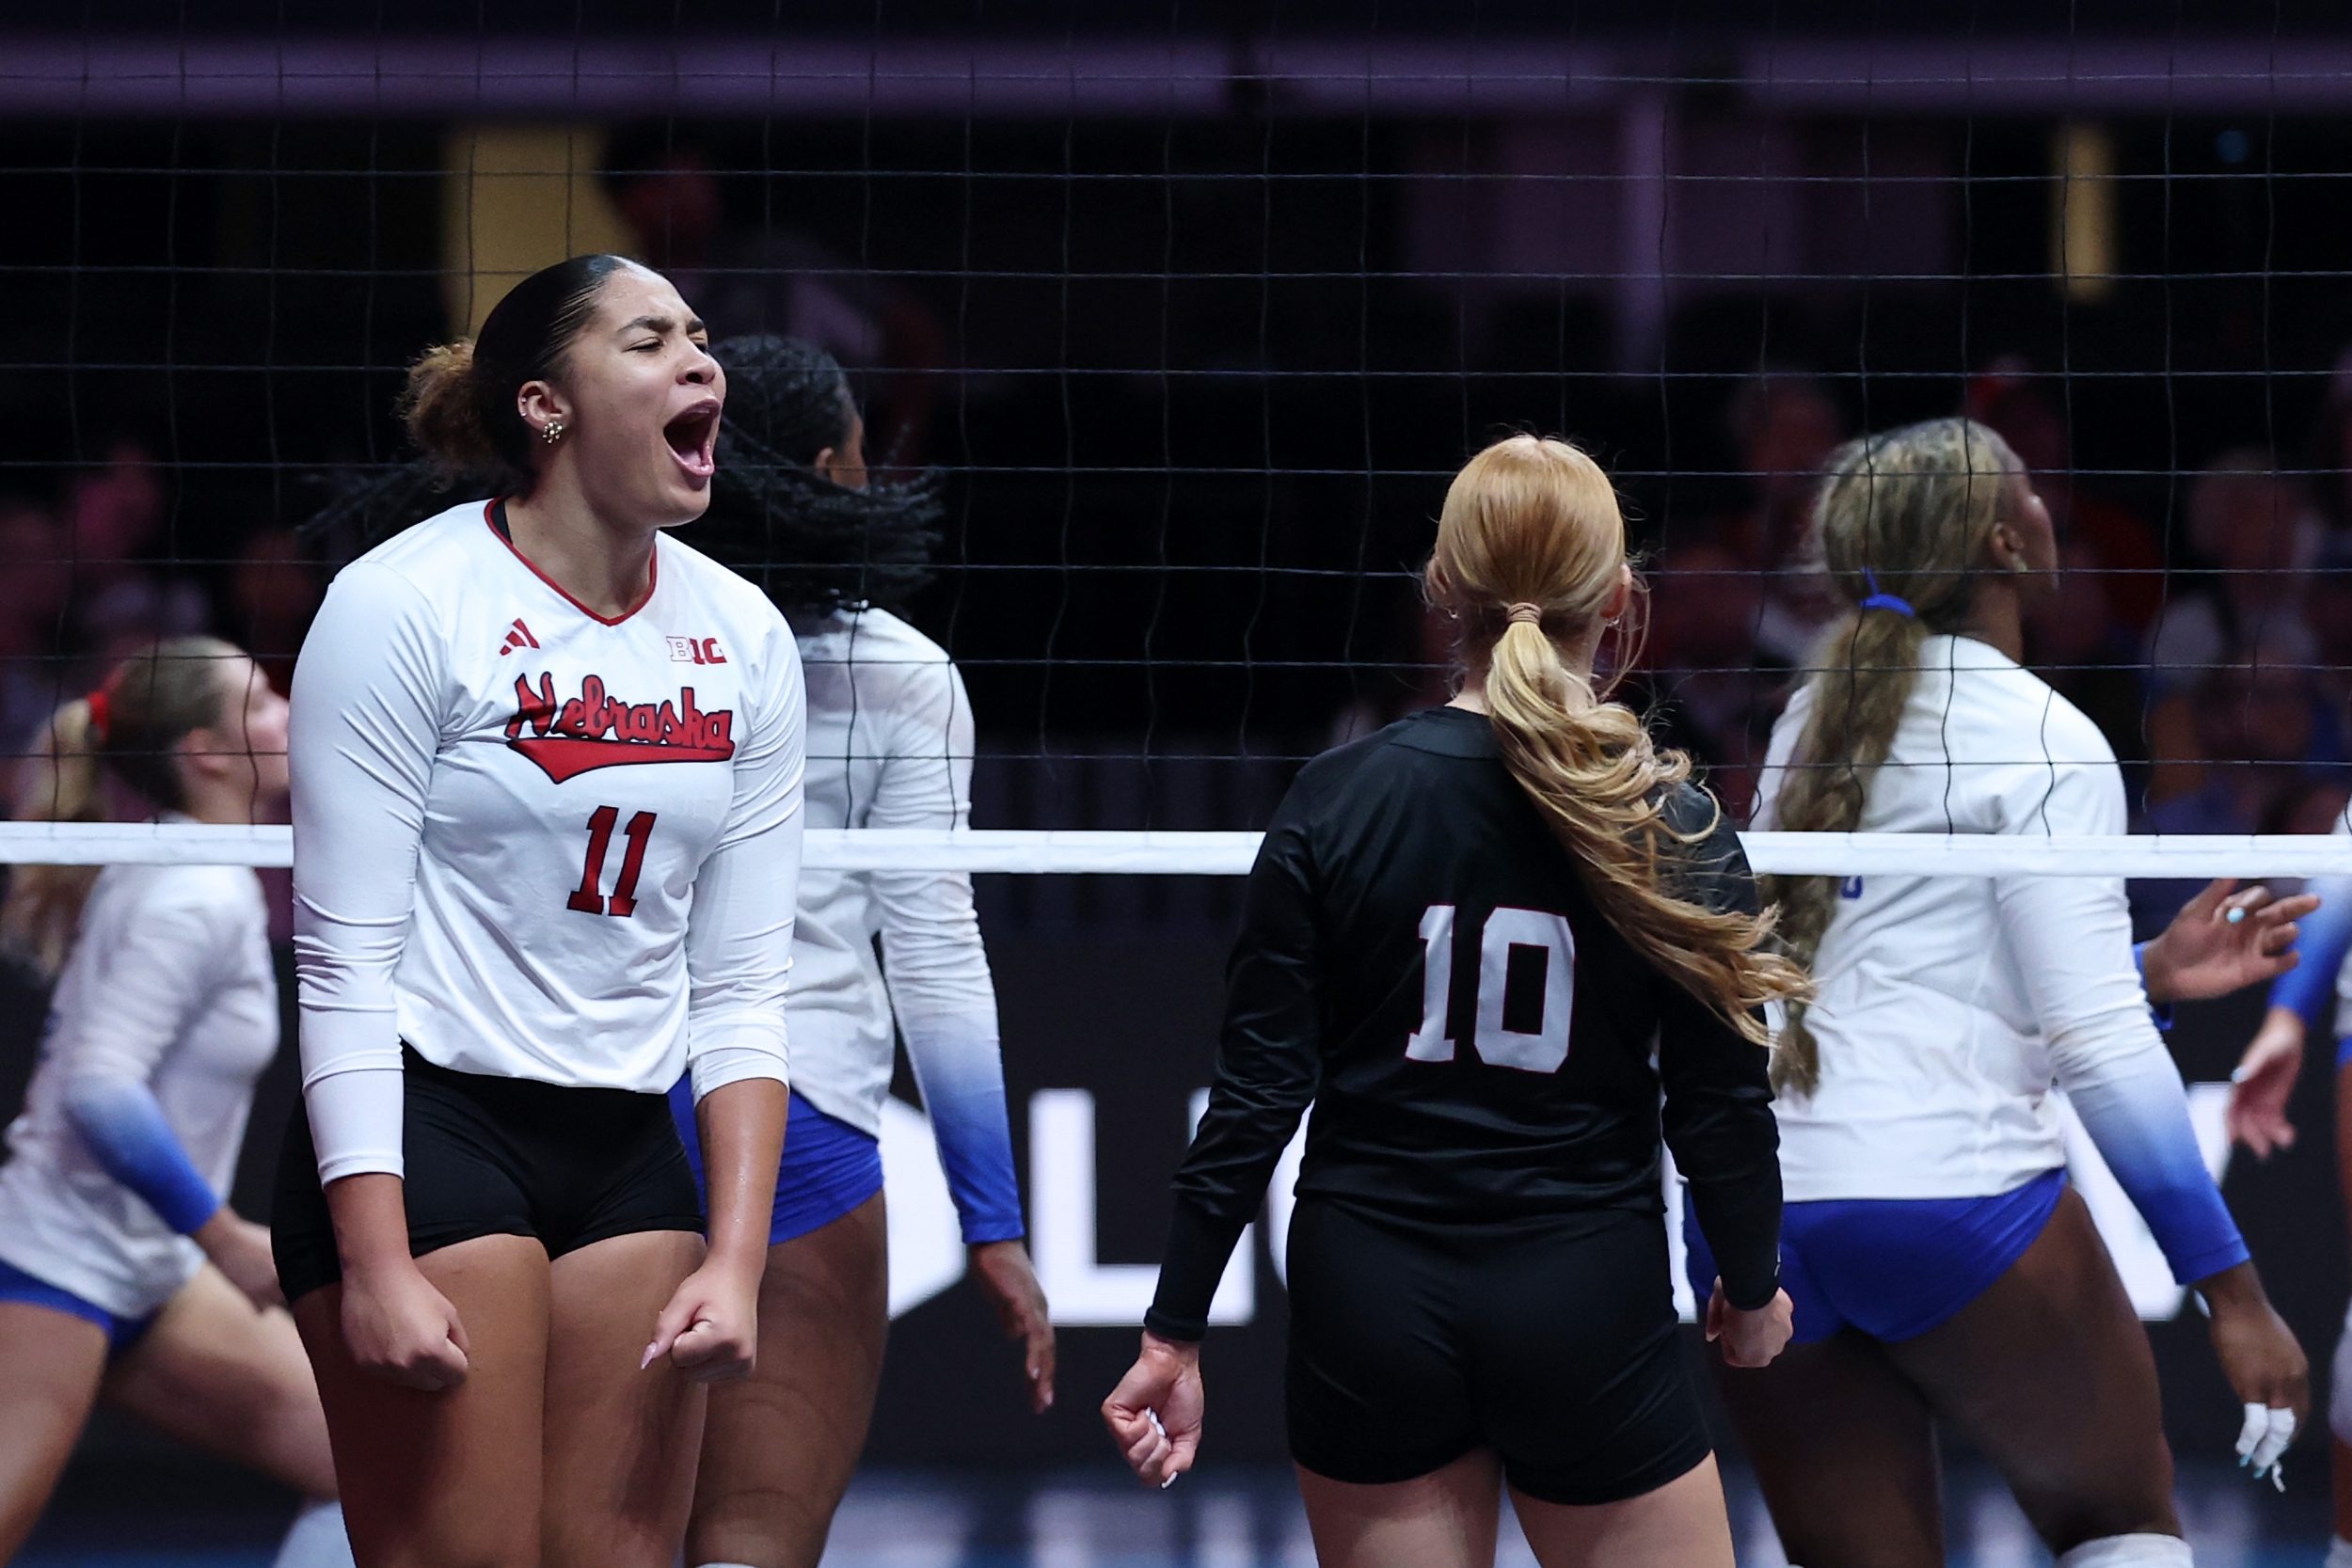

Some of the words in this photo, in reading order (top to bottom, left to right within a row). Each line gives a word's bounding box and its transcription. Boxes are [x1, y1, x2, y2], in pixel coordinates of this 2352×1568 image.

[504, 672, 736, 750] Nebraska
[566, 805, 658, 917] 11
[1405, 903, 1576, 1074] 10
